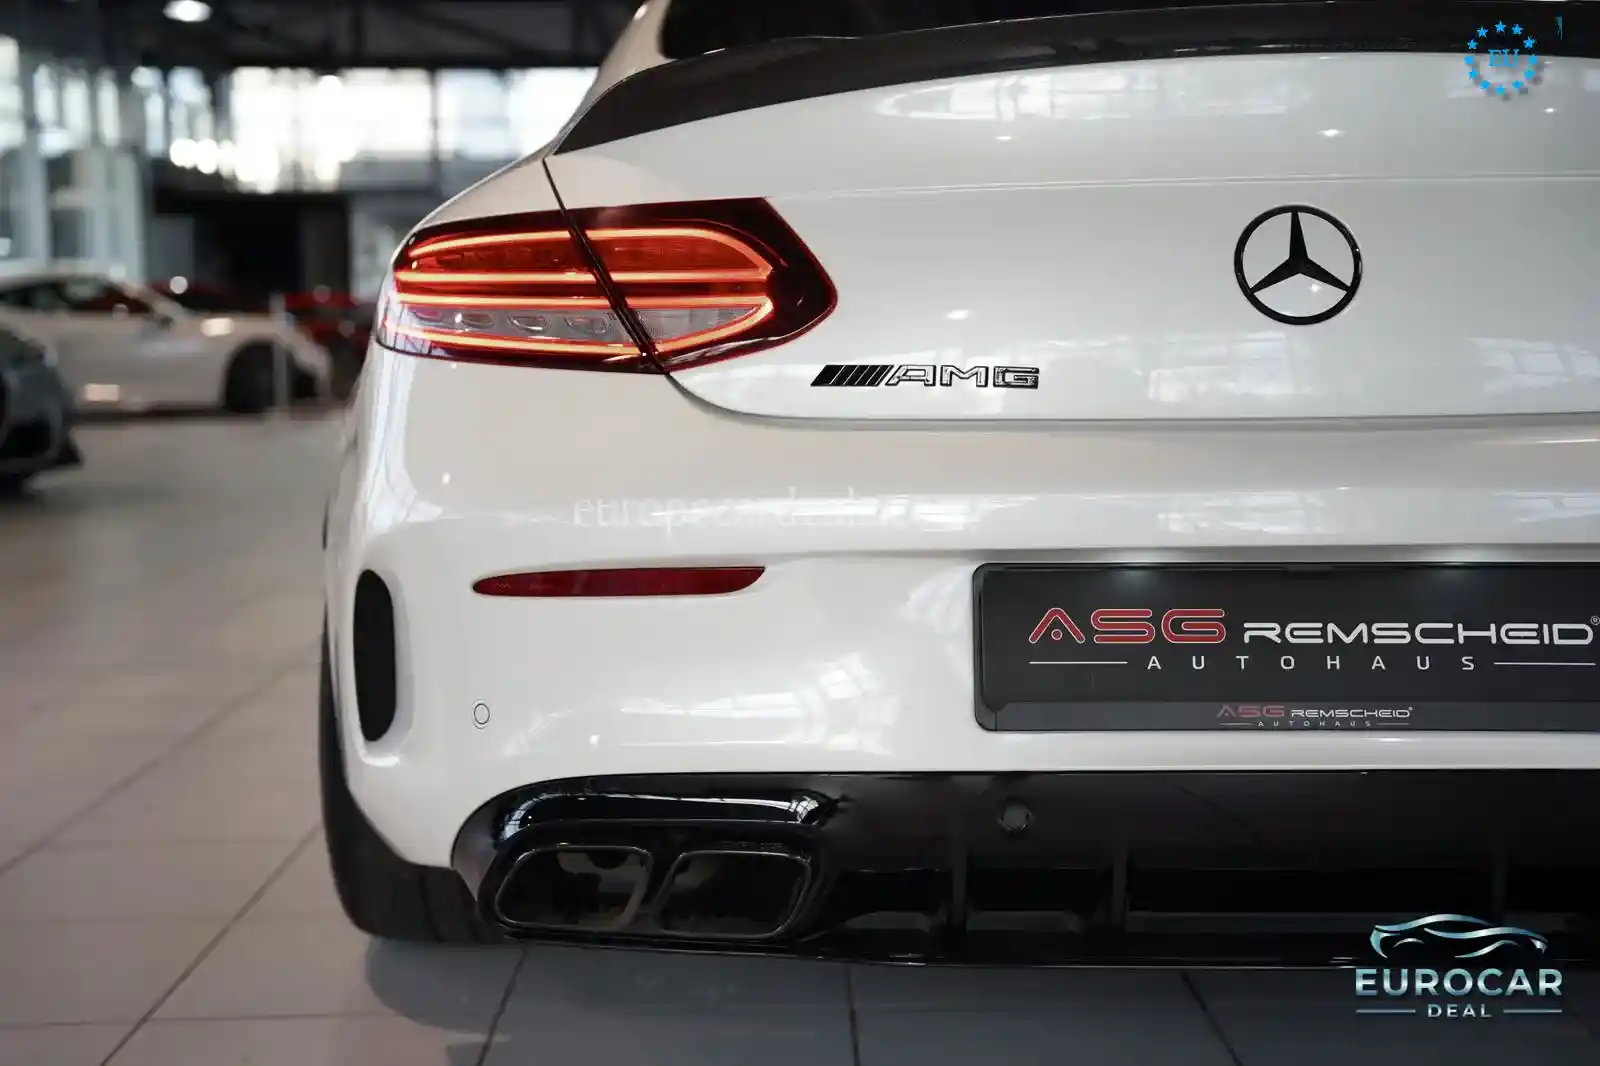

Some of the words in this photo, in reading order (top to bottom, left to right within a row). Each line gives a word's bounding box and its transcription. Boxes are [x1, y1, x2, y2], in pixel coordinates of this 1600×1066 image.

[885, 364, 1040, 389] AMG
[1029, 607, 1226, 644] ASG
[1147, 655, 1475, 671] AUTOHAUS
[1217, 704, 1284, 718] ASG
